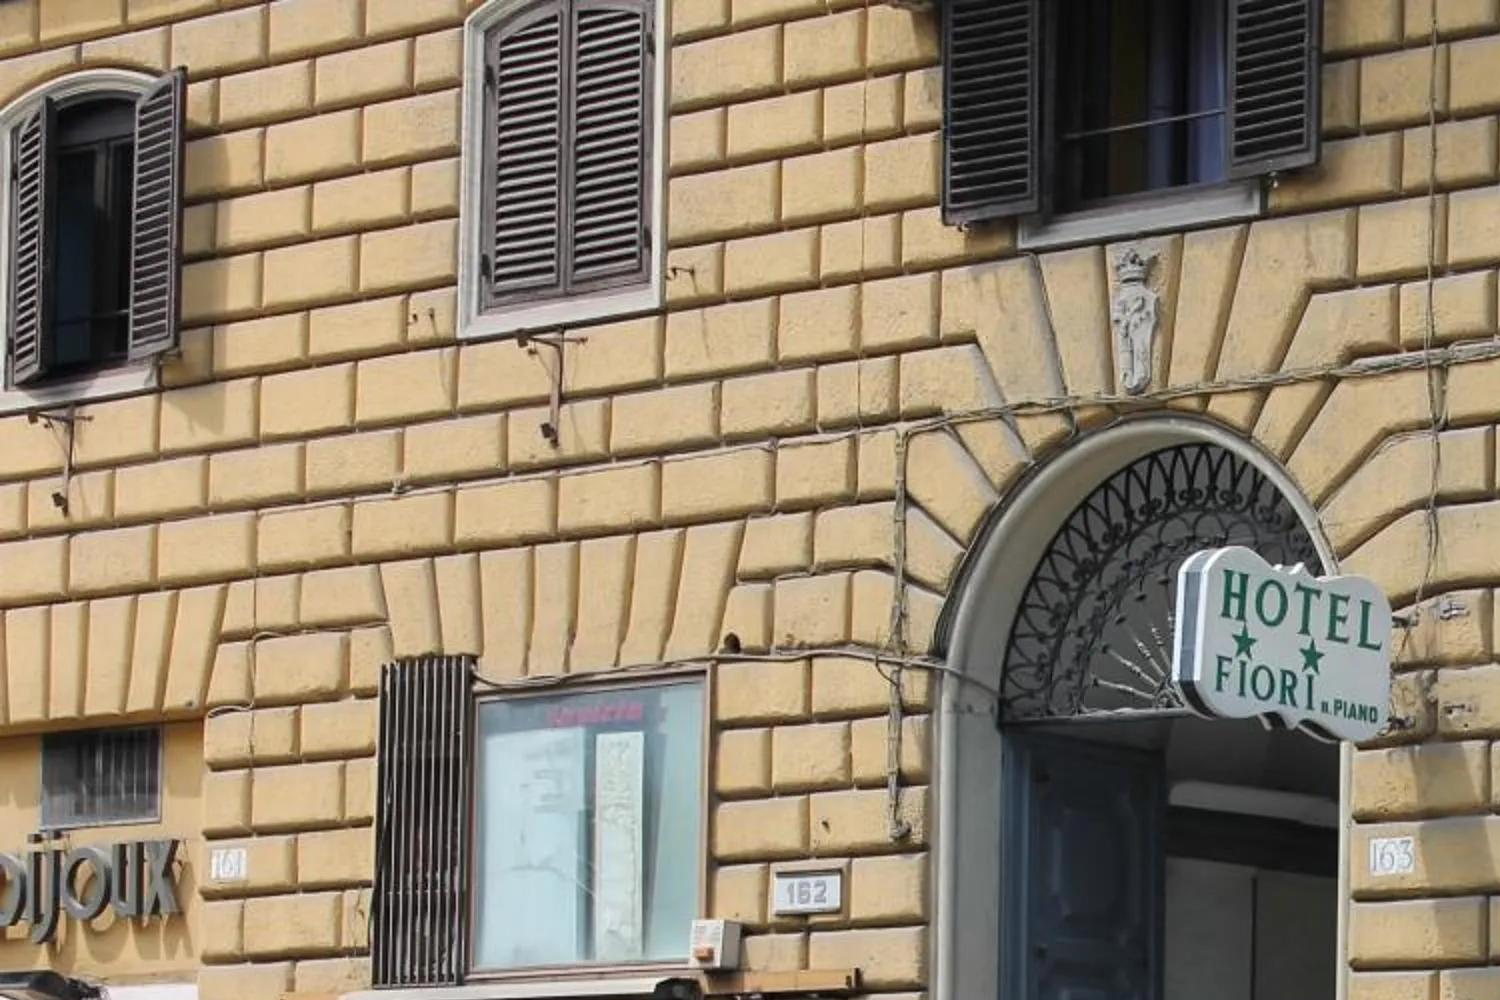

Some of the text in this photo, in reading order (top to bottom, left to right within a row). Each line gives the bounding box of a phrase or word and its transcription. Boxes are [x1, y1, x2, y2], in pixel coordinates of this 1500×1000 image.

[1220, 569, 1382, 652] HOTEL
[1215, 654, 1316, 711] FIORI
[1333, 698, 1379, 724] PIANO
